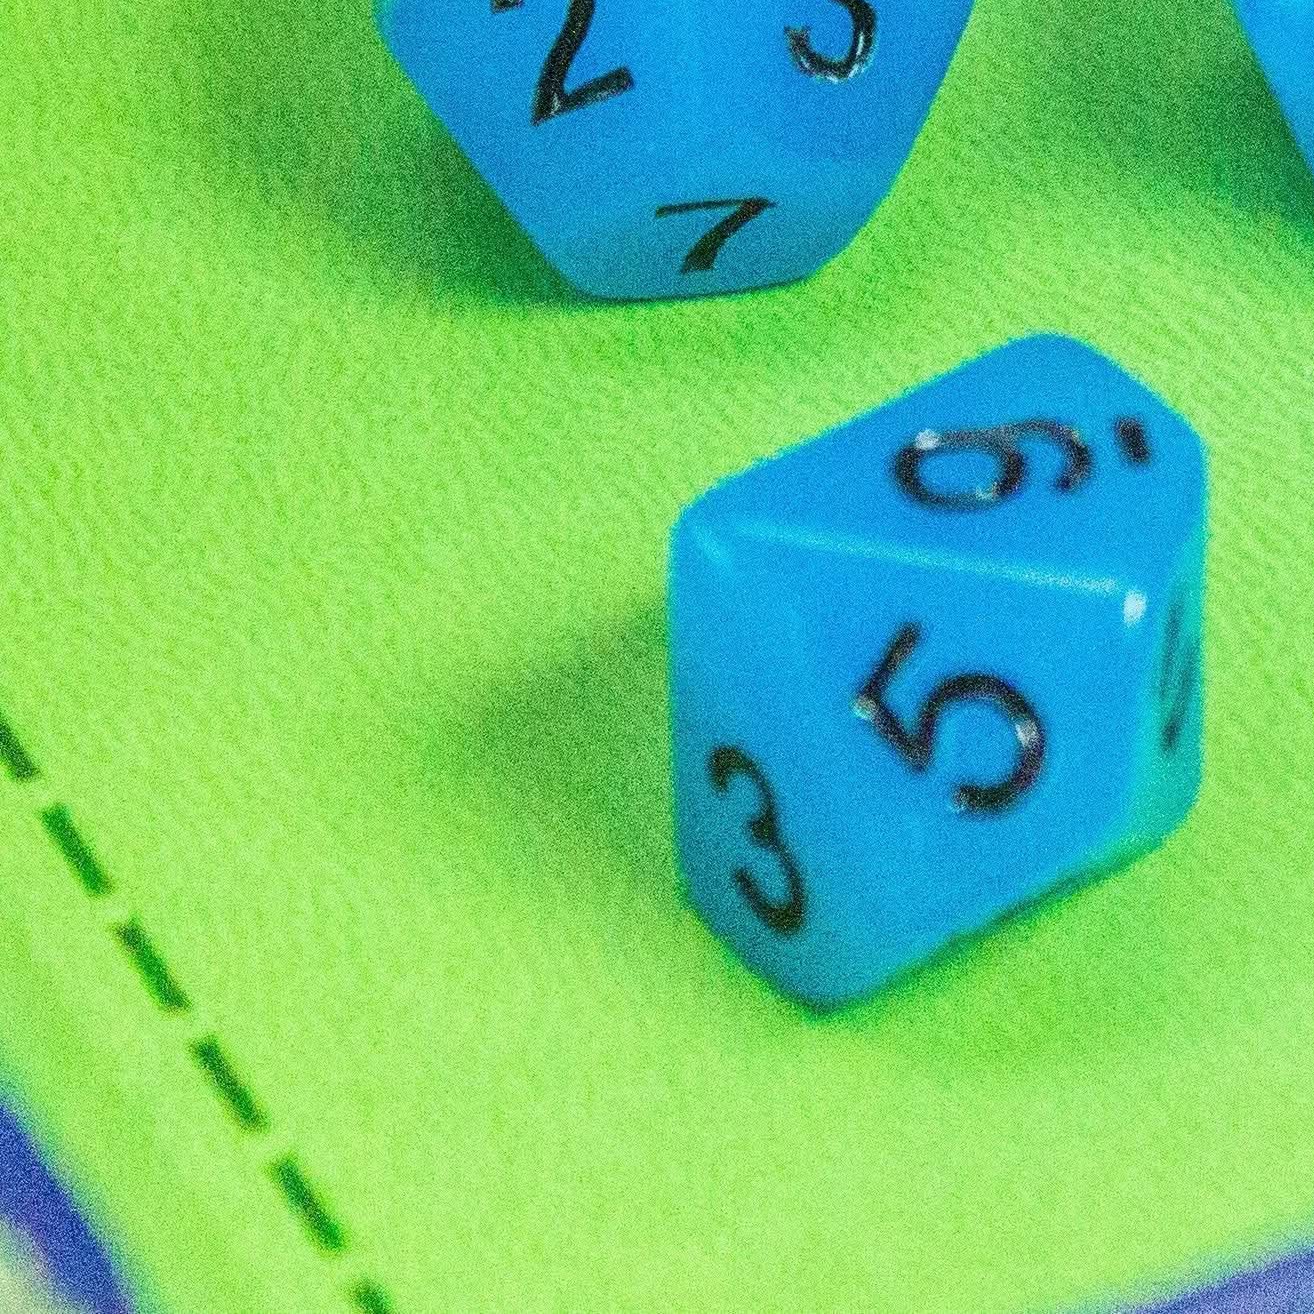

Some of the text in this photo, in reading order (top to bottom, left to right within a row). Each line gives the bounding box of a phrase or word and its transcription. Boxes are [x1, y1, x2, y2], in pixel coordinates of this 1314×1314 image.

[655, 198, 777, 274] 7
[852, 623, 1046, 820] 5
[710, 746, 805, 936] 3
